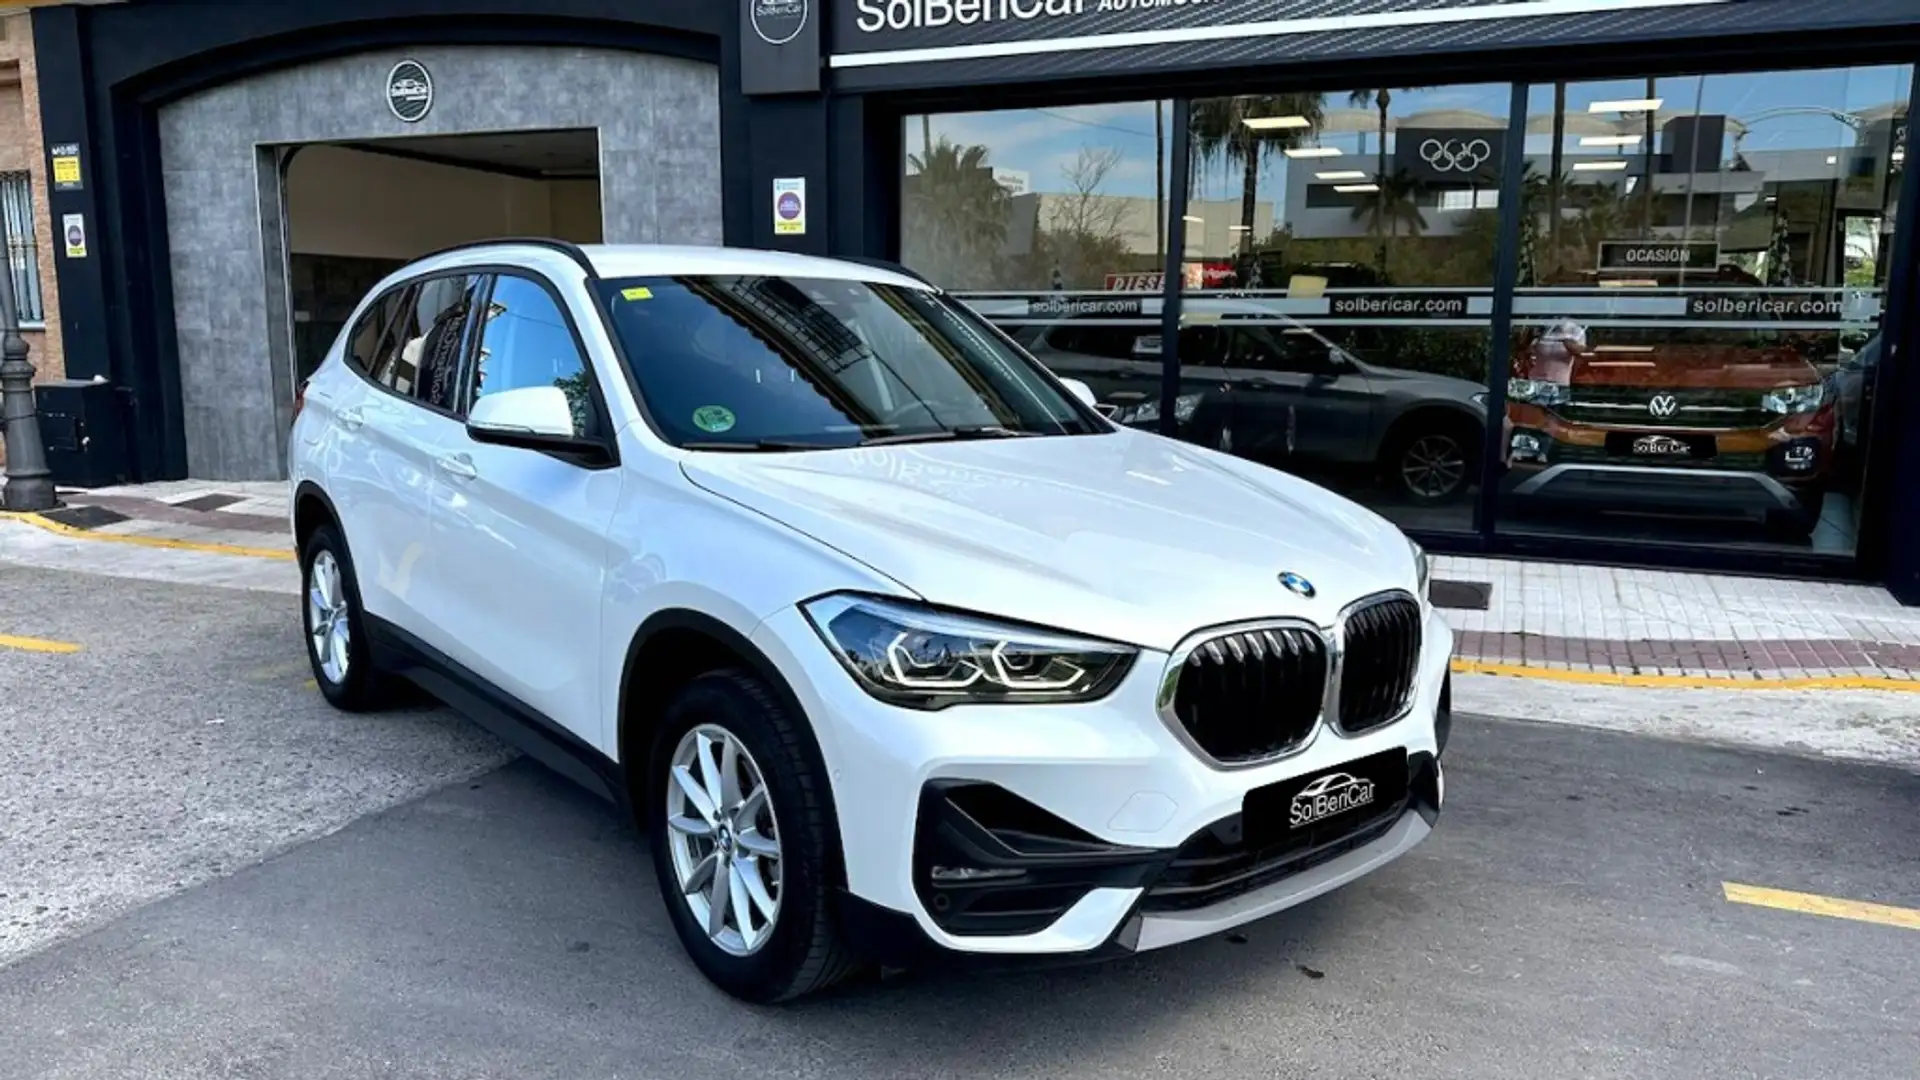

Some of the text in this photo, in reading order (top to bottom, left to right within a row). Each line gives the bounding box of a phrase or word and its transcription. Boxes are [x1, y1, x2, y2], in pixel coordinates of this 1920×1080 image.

[1626, 247, 1690, 261] OCASIÓN
[1335, 298, 1462, 312] solbericar.com
[1693, 298, 1842, 313] solbericar.com
[1290, 783, 1375, 825] SolBeriCar
